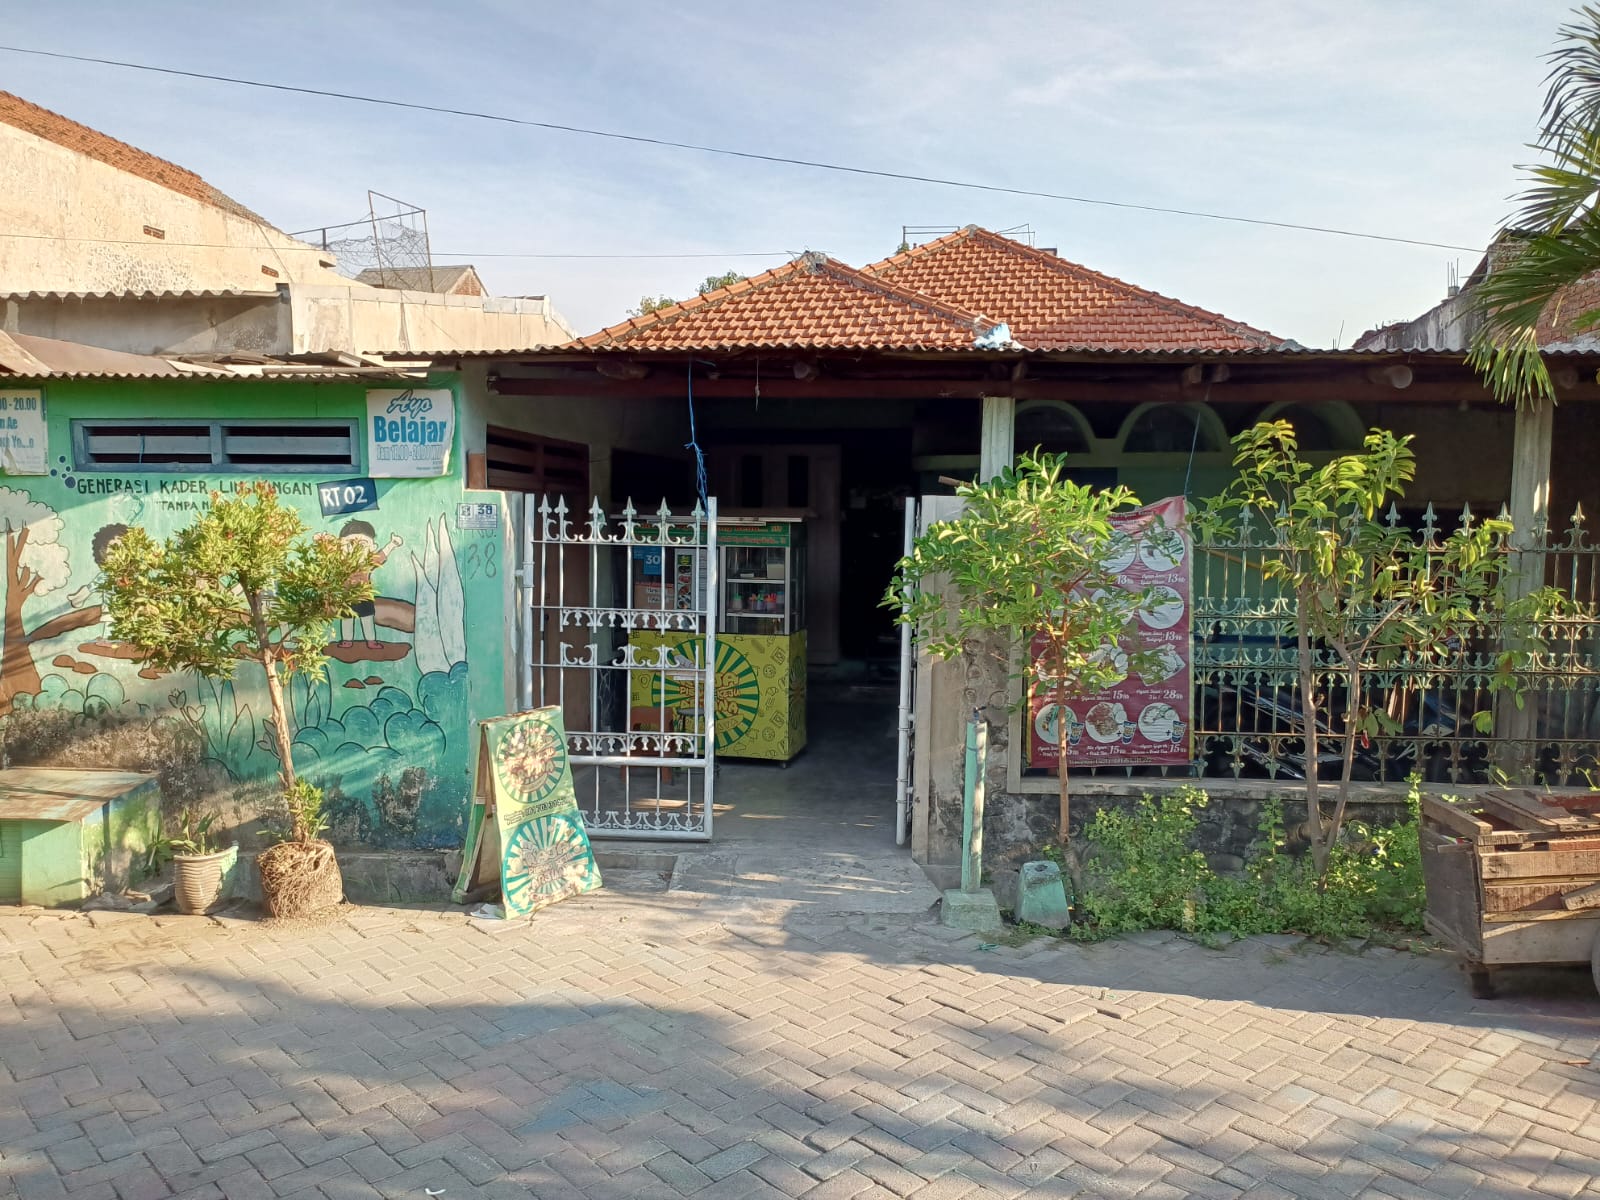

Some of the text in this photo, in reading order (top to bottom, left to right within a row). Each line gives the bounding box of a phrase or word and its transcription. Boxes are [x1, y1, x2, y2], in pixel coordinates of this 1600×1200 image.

[14, 397, 37, 410] 20.00
[386, 388, 433, 419] Ayo
[374, 415, 447, 446] Belajar
[77, 478, 149, 494] GENERASI
[160, 480, 208, 494] KADER
[320, 485, 368, 507] RT 02
[477, 503, 493, 515] 38
[645, 554, 661, 565] 30
